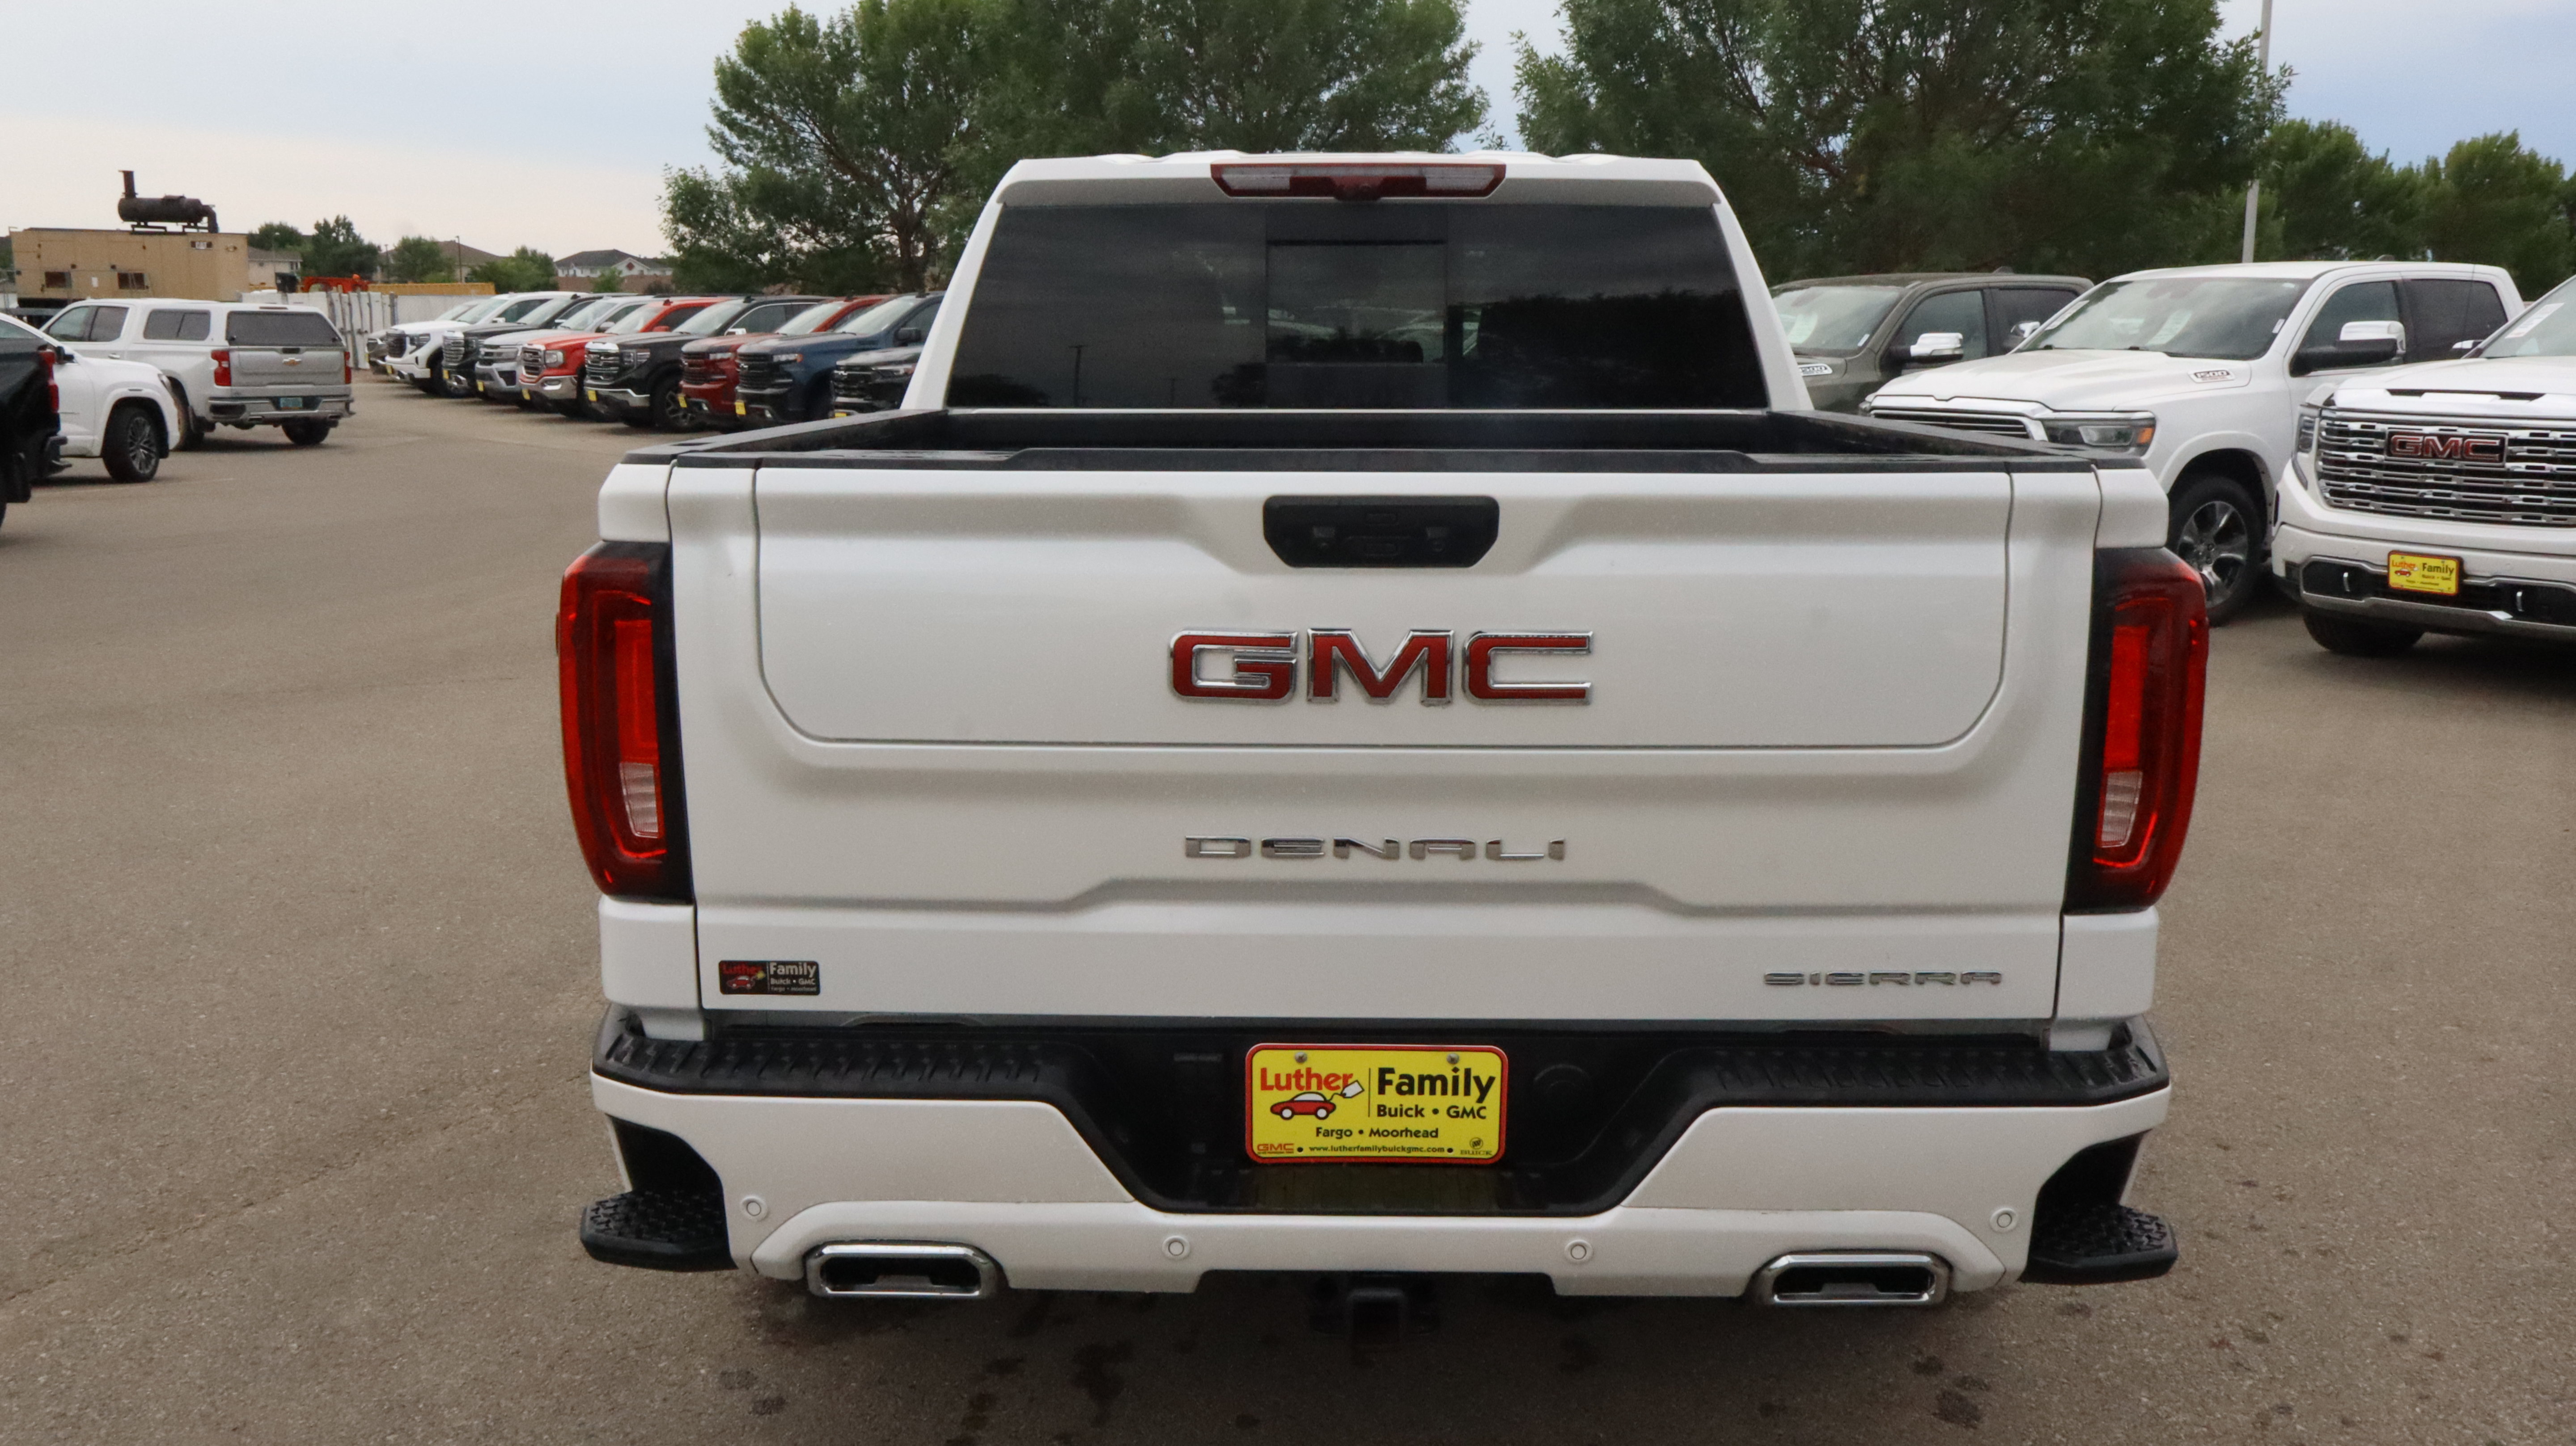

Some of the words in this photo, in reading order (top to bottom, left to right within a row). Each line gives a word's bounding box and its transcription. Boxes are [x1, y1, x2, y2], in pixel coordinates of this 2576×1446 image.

[2391, 435, 2501, 461] GMC
[2422, 563, 2454, 576] Family
[1170, 628, 1593, 706] GMC
[1185, 835, 1565, 861] DENALI
[770, 962, 817, 978] Family
[1764, 971, 2002, 985] SIERRA
[1260, 1067, 1353, 1091] Luther
[1377, 1066, 1496, 1103] Family
[1377, 1104, 1425, 1118] Buick
[1446, 1105, 1487, 1119] GMC
[1316, 1127, 1353, 1139] Fargo
[1368, 1127, 1439, 1138] Moorhead
[1257, 1143, 1294, 1151] GMC
[1309, 1145, 1445, 1153] www.lutherfamilybuickgmc.com
